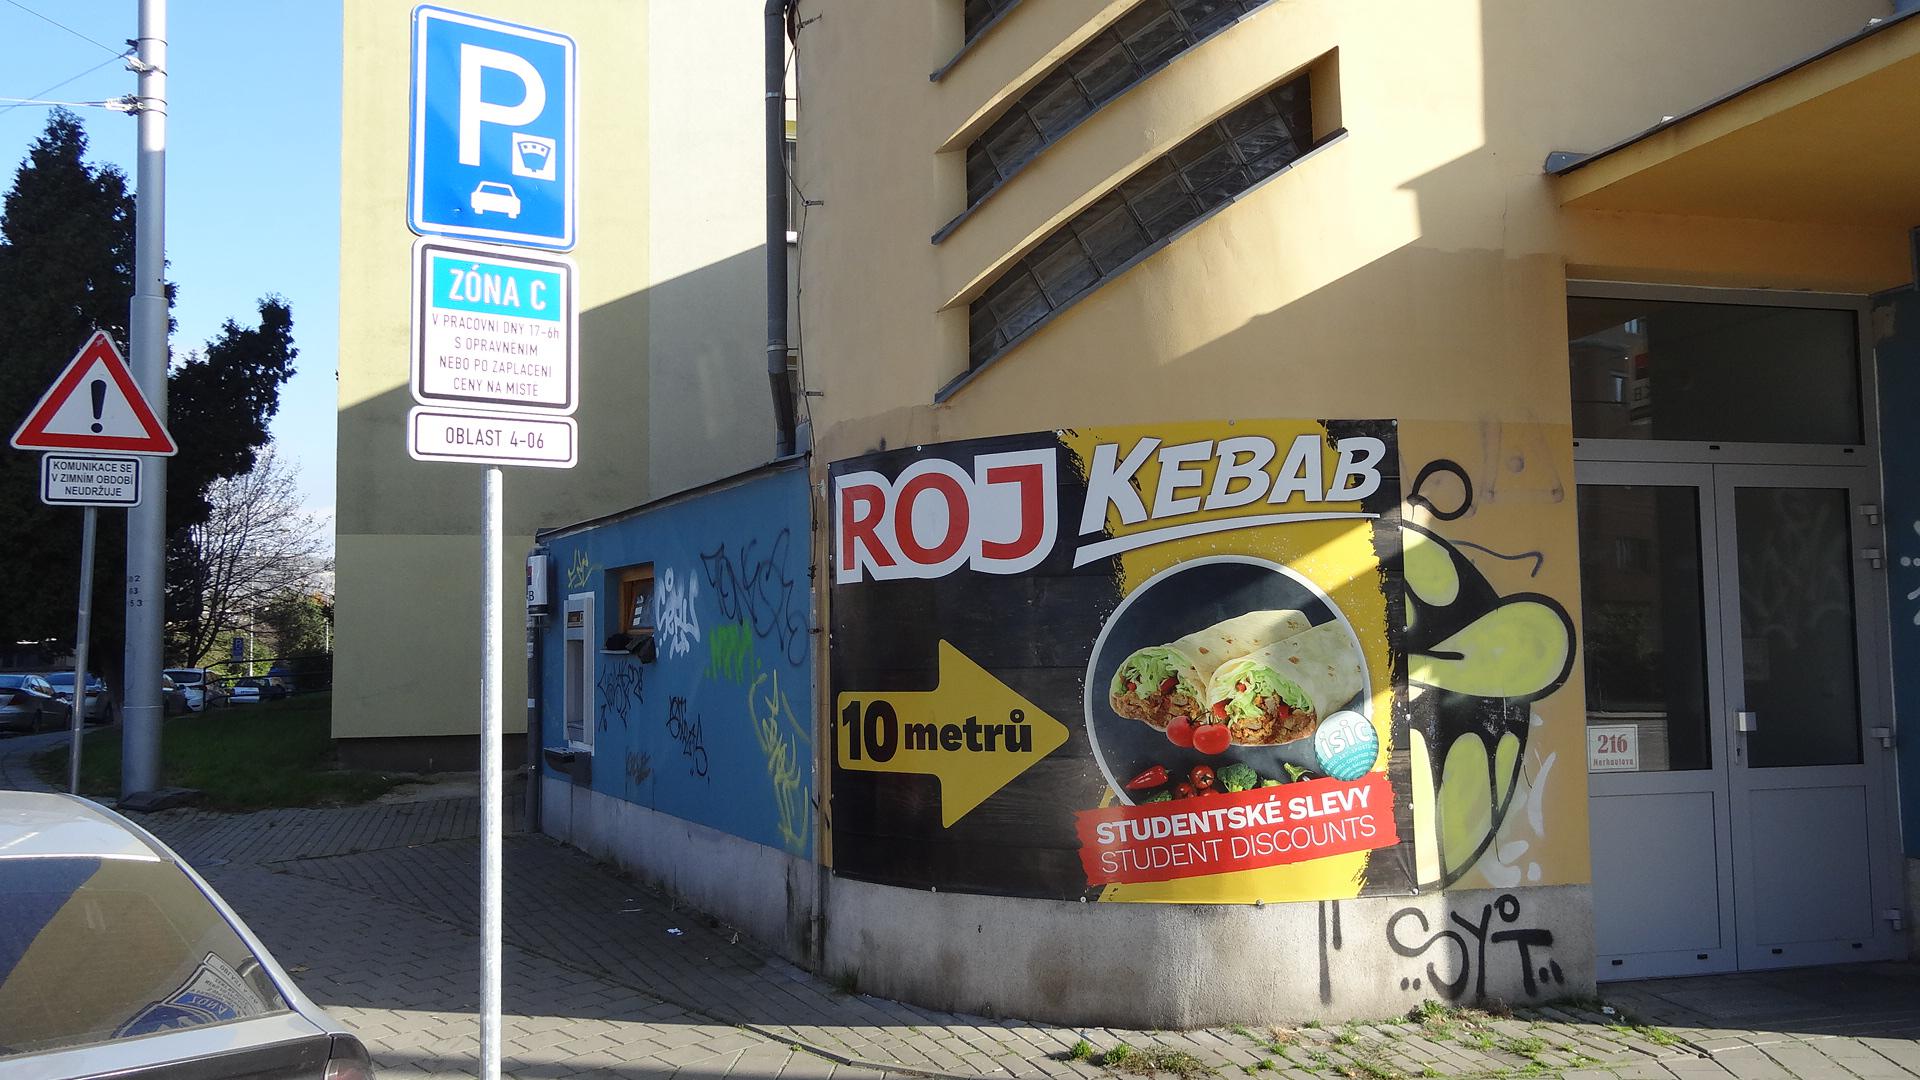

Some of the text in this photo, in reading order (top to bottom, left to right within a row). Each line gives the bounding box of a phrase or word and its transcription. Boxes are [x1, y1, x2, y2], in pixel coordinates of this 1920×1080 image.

[458, 42, 547, 167] P
[448, 264, 547, 311] ZÓNA C
[432, 313, 439, 326] V
[503, 321, 525, 335] DNY
[529, 324, 560, 339] 17-6h
[454, 336, 461, 349] S
[439, 355, 470, 371] NEBO
[474, 358, 488, 372] PO
[453, 377, 483, 392] CENY
[486, 380, 502, 394] NA
[445, 426, 544, 449] OBLAST 4-06
[51, 472, 134, 485] V ZIMNÍM OBDOBÍ
[53, 461, 132, 473] KOMUNIKACE SE
[64, 485, 122, 497] NEUDRŽUJE
[838, 434, 1387, 578] ROJ KEBAB
[841, 700, 1033, 763] 10 metrů
[1319, 719, 1371, 761] isic
[1597, 733, 1628, 754] 216
[1096, 785, 1372, 844] STUDENTSKÉ SLEVY
[1101, 814, 1377, 874] STUDENT DISCOUNTS
